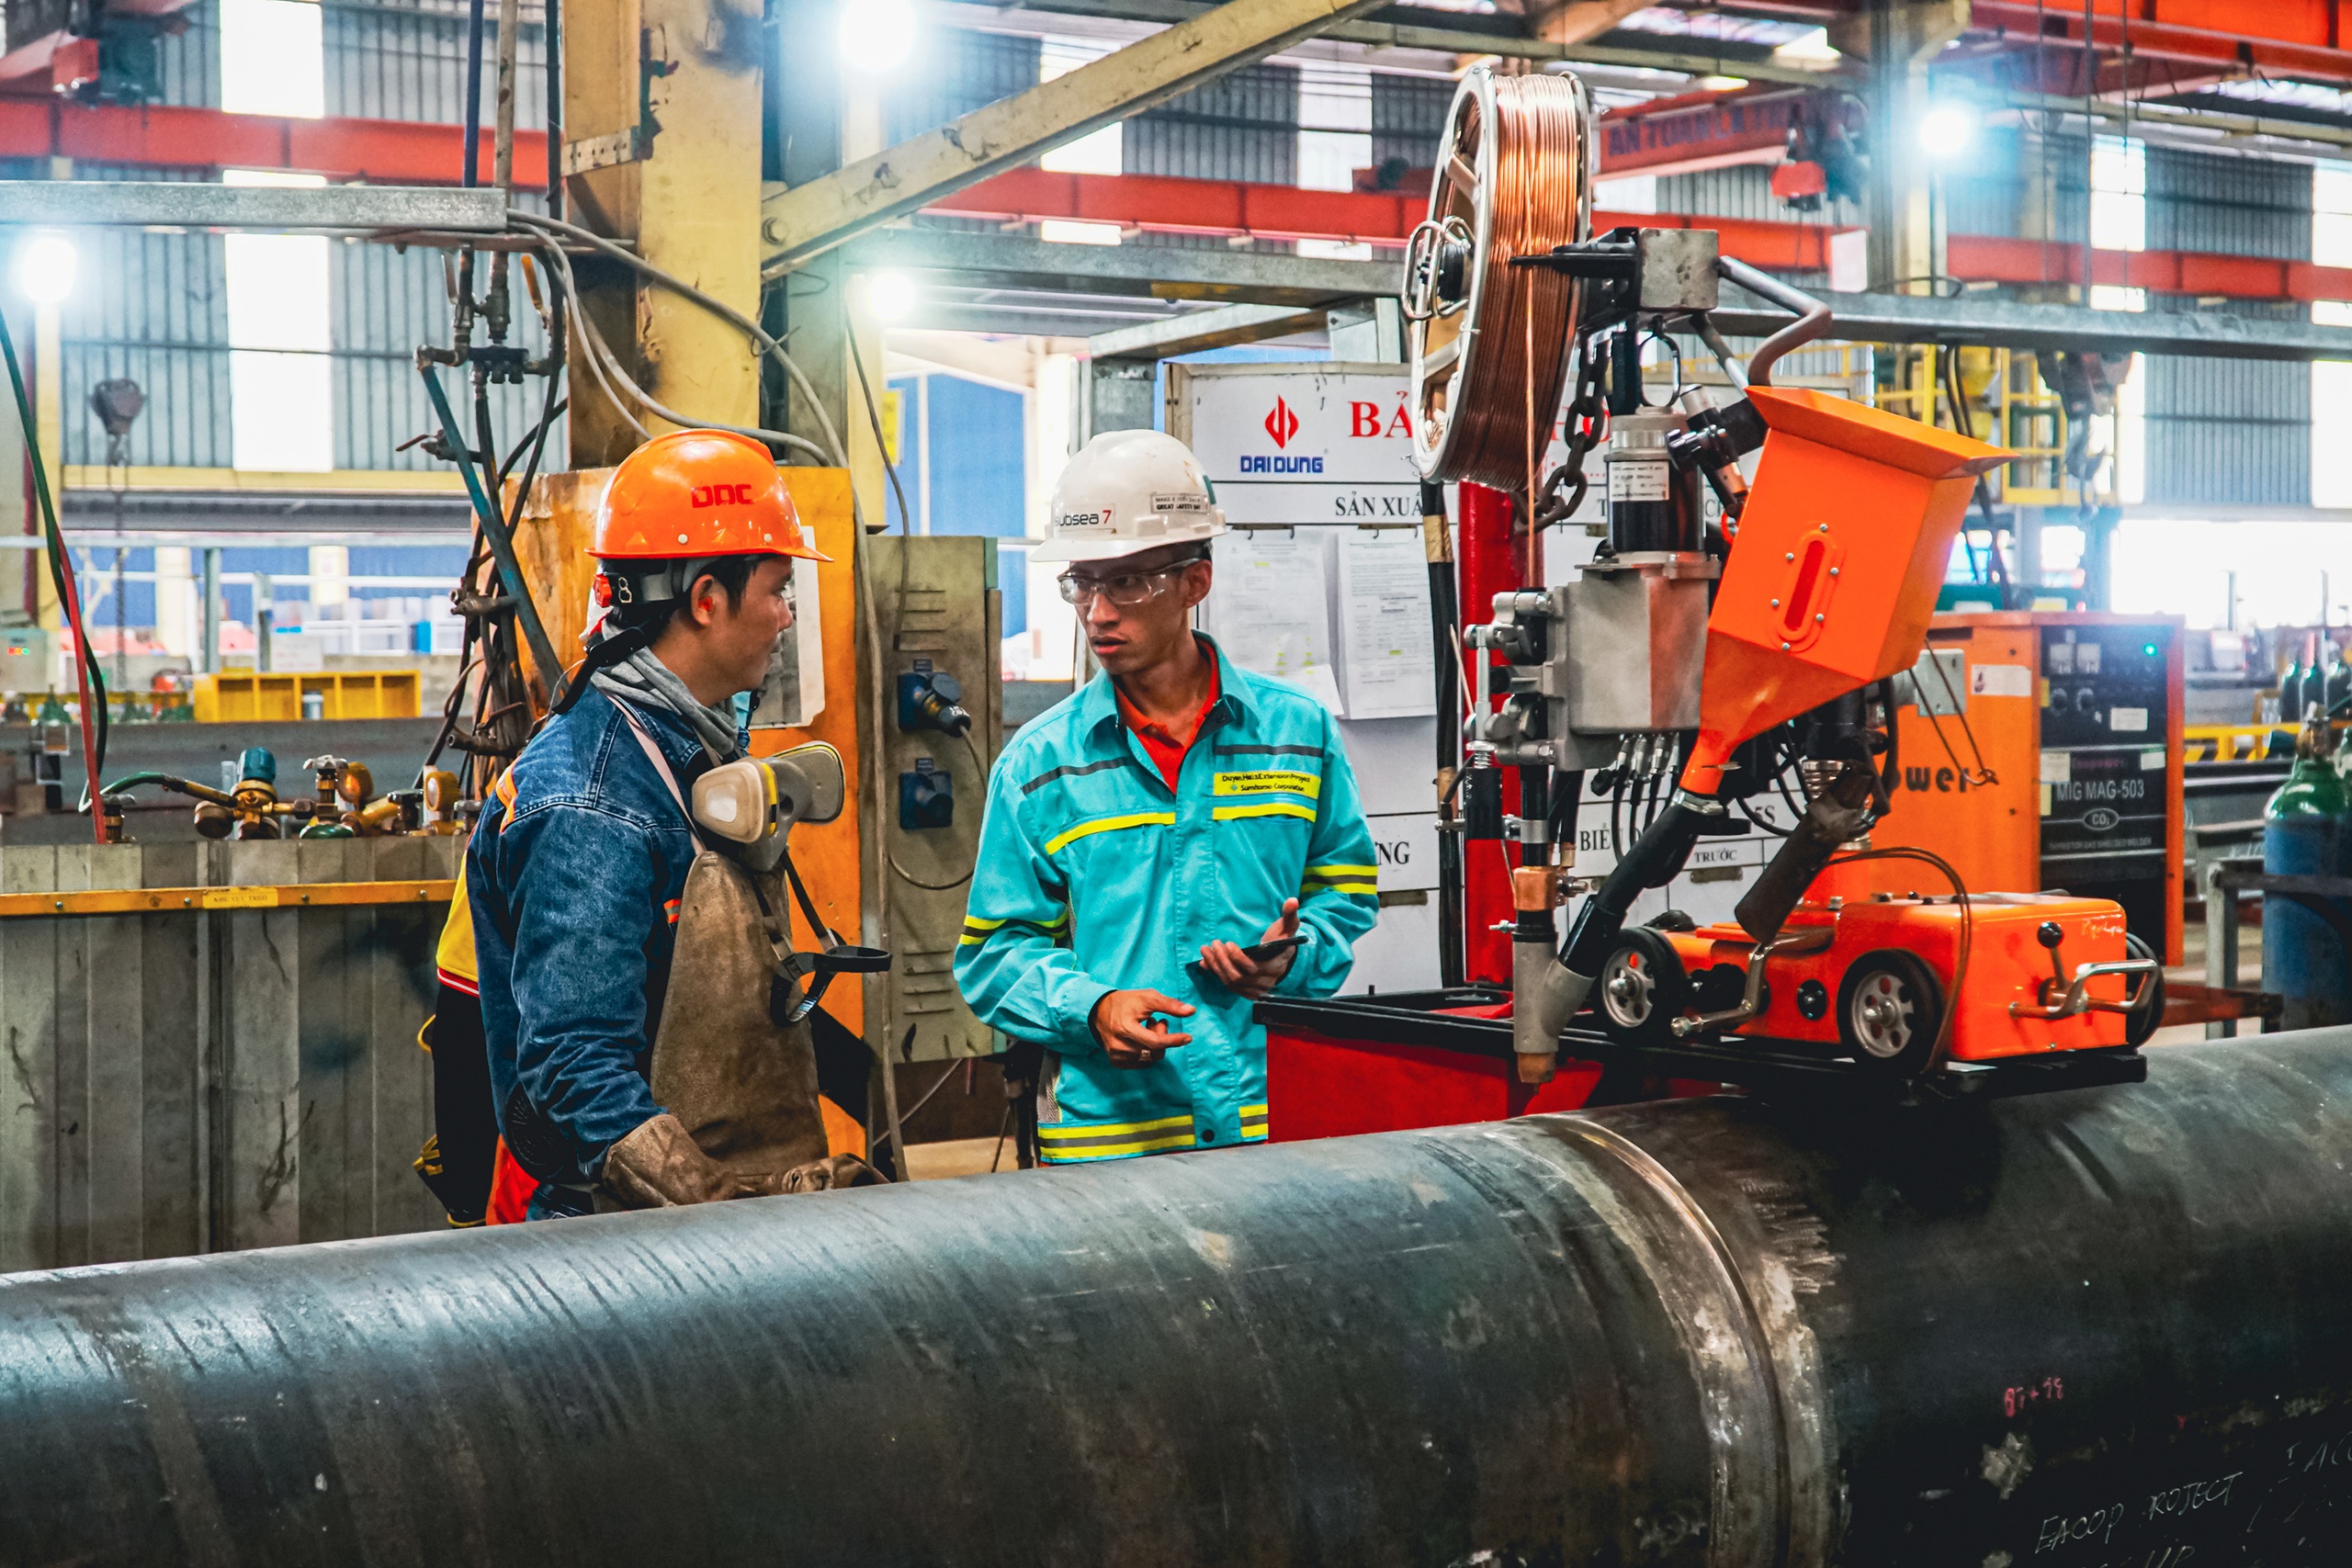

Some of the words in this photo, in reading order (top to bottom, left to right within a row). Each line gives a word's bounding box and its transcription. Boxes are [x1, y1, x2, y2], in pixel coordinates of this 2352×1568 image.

[1348, 390, 1413, 438] BẢ
[1336, 491, 1375, 516] SẢN
[1102, 509, 1113, 525] 7
[2056, 782, 2083, 802] MIG
[2086, 779, 2145, 800] MAG-503
[1374, 840, 1410, 865] NG
[2143, 1472, 2244, 1521] ROJECT
